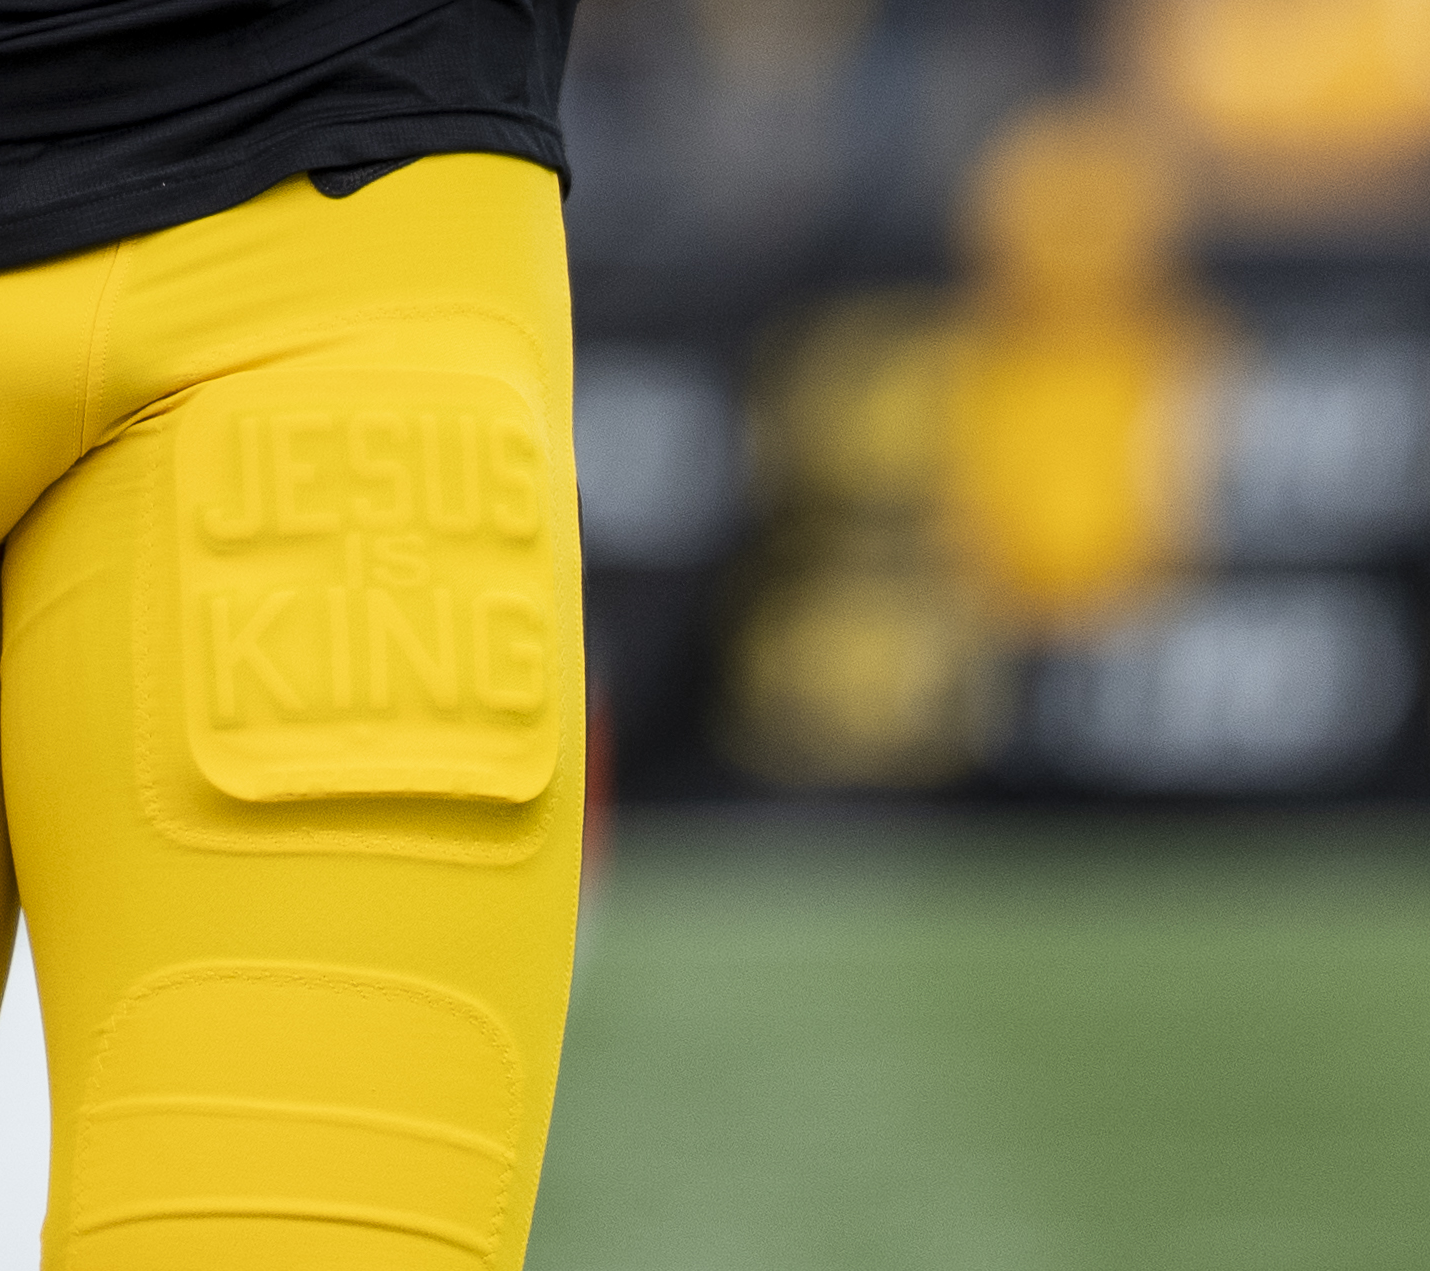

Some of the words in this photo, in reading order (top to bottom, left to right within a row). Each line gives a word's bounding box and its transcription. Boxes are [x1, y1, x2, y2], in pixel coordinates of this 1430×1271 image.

[204, 408, 544, 538] JESUS
[344, 530, 431, 589] IS
[211, 584, 548, 718] KING
